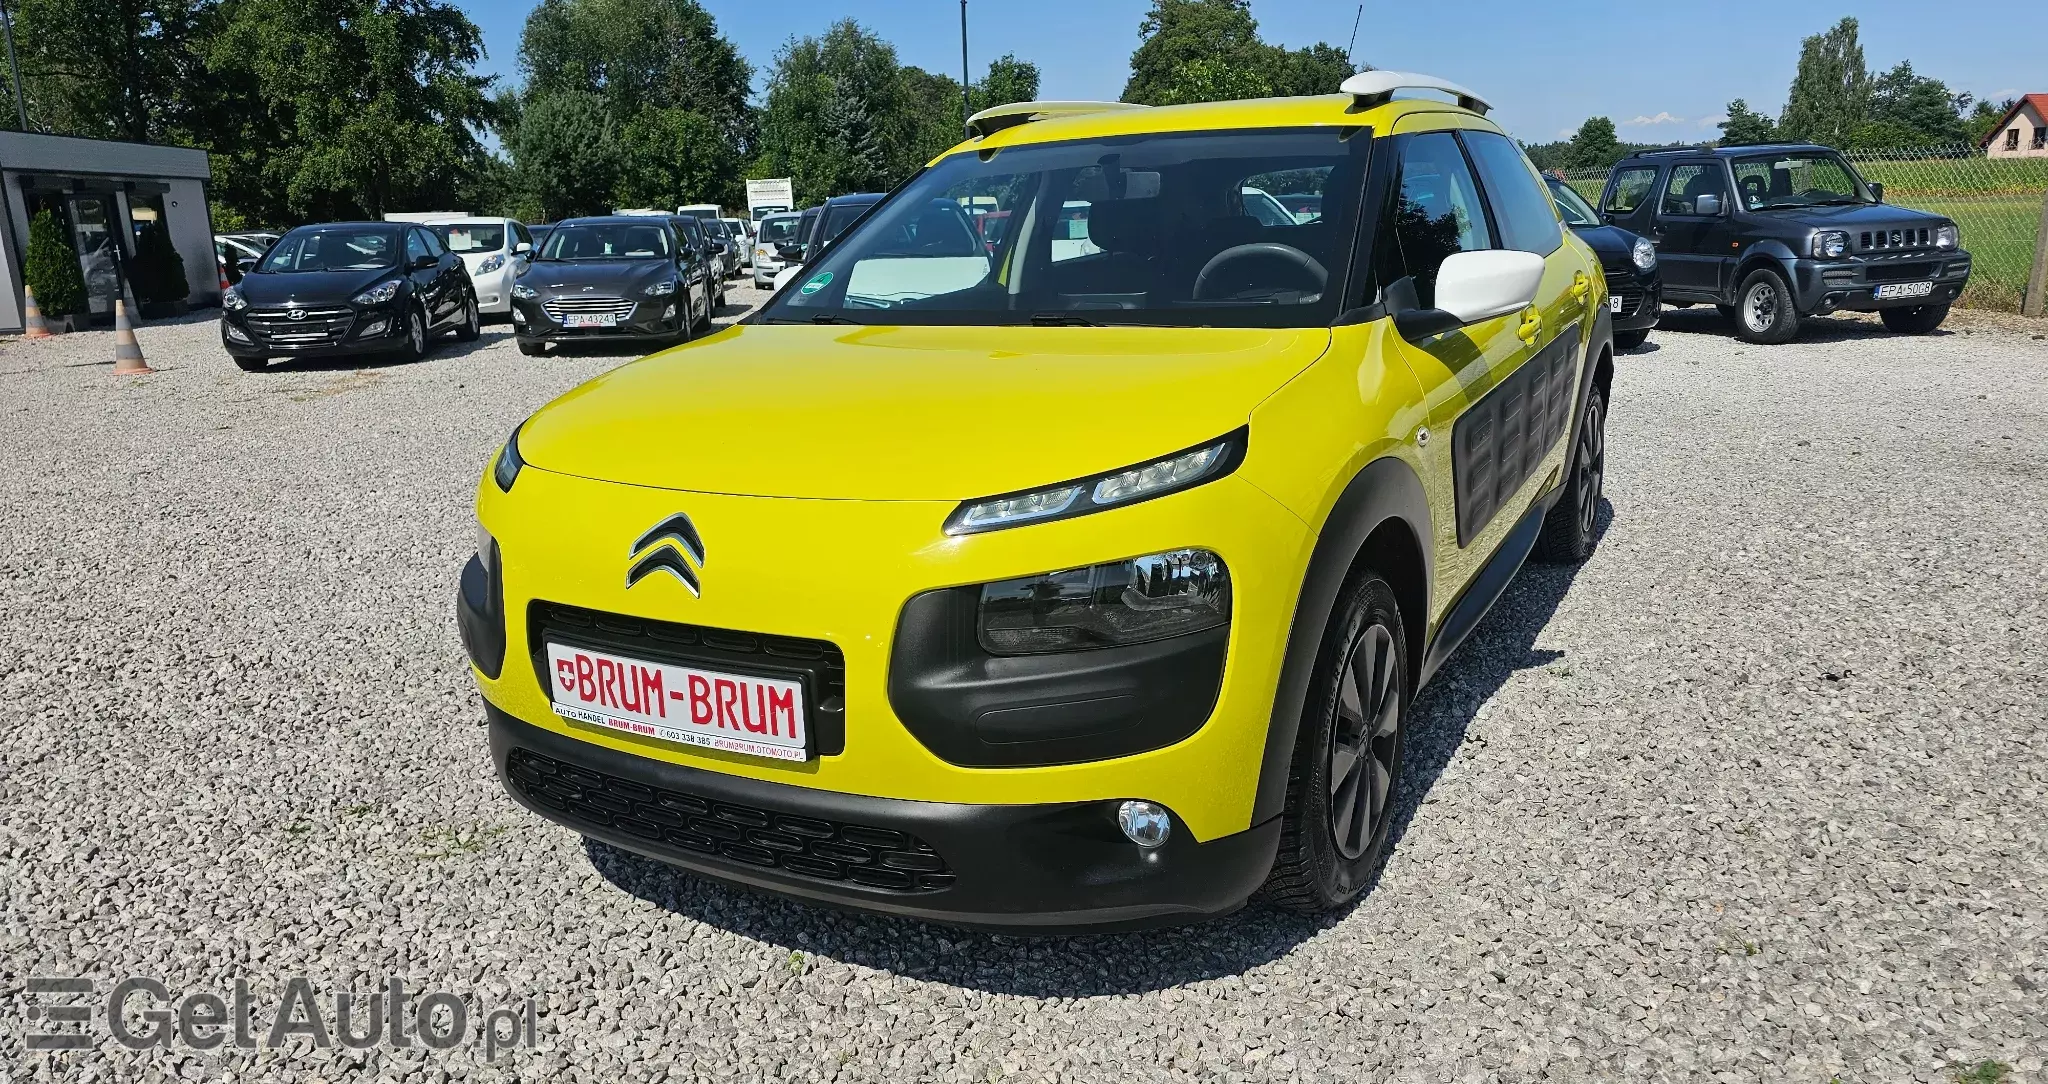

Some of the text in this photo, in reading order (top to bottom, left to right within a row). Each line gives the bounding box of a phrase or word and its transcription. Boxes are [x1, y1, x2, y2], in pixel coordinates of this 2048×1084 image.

[1881, 285, 1903, 297] EPA
[568, 314, 615, 325] EPA 43243
[575, 654, 797, 739] BRUM-BRUM
[555, 707, 577, 718] AUTO
[578, 710, 606, 725] HANDEL
[608, 718, 655, 735] BRUM-BRUM
[666, 731, 680, 740] 603
